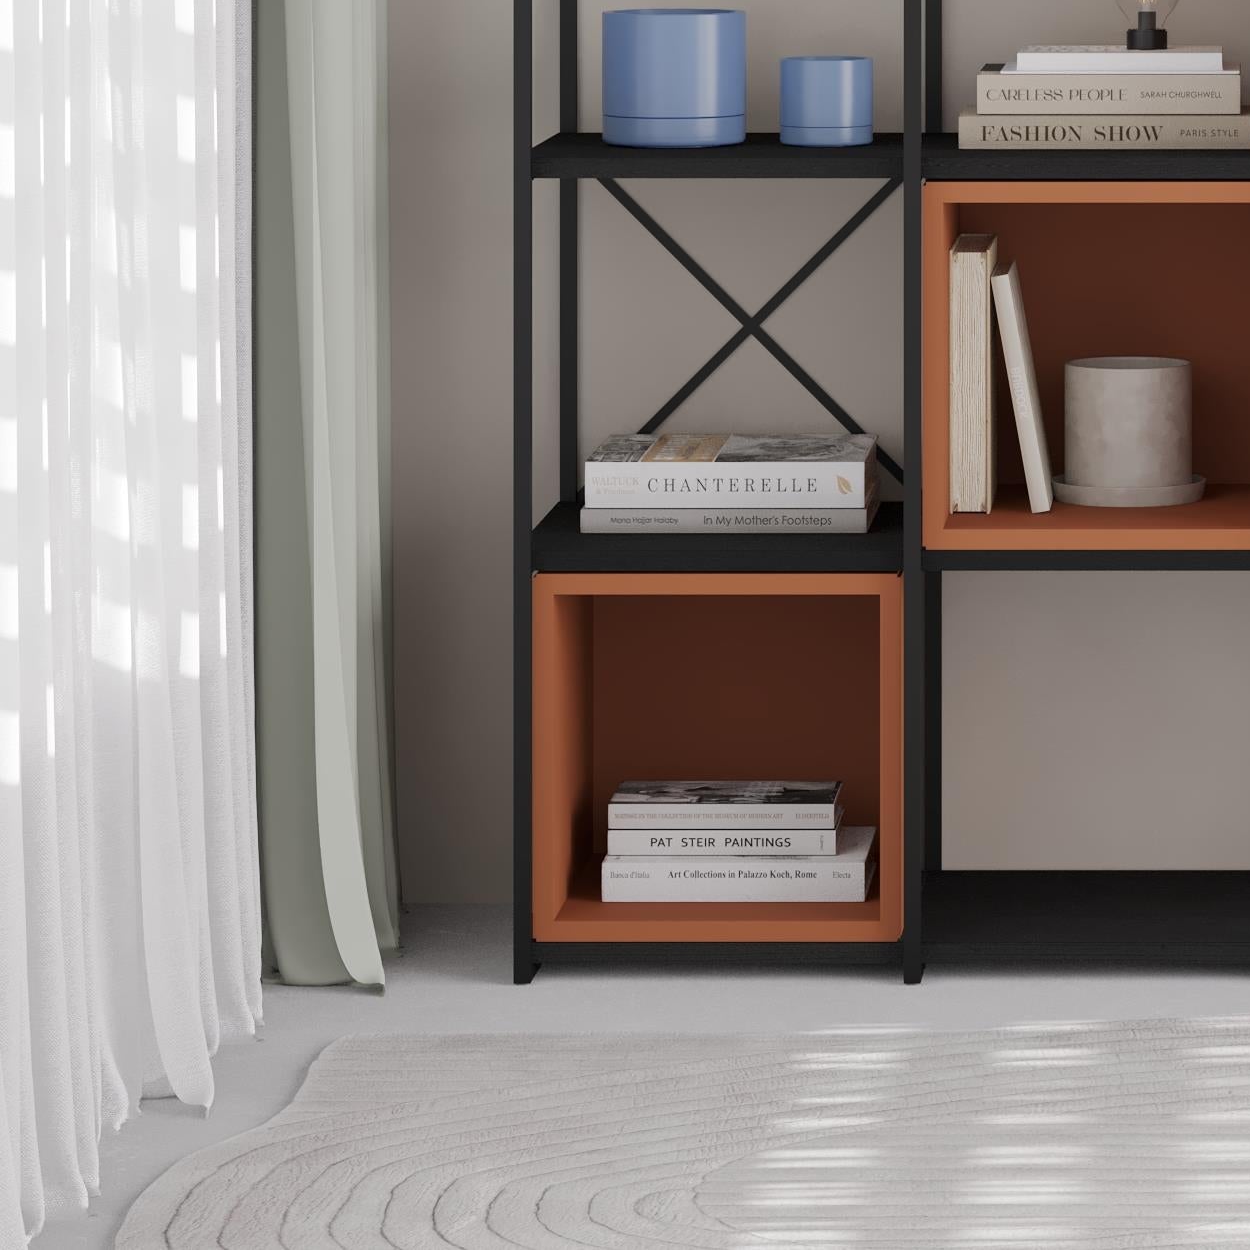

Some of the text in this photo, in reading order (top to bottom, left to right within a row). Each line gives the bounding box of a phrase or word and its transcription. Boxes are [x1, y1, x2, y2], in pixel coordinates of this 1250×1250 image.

[986, 89, 1063, 101] CARELESS
[1069, 89, 1127, 101] PEOPLE
[1140, 91, 1167, 99] SARAH
[981, 125, 1239, 142] FASHION SHOW PARIS STYLE
[647, 477, 818, 493] CHANTERELLE
[703, 516, 713, 525] In
[715, 516, 732, 527] My
[734, 516, 780, 525] Mother's
[781, 515, 832, 528] Footsteps
[650, 838, 792, 847] PAT STEIR PAINTINGS
[667, 871, 681, 879] Art
[683, 870, 726, 879] Collections
[728, 871, 735, 879] in
[737, 870, 768, 879] Palazzo
[770, 870, 793, 880] Koch,
[795, 870, 817, 879] Rome
